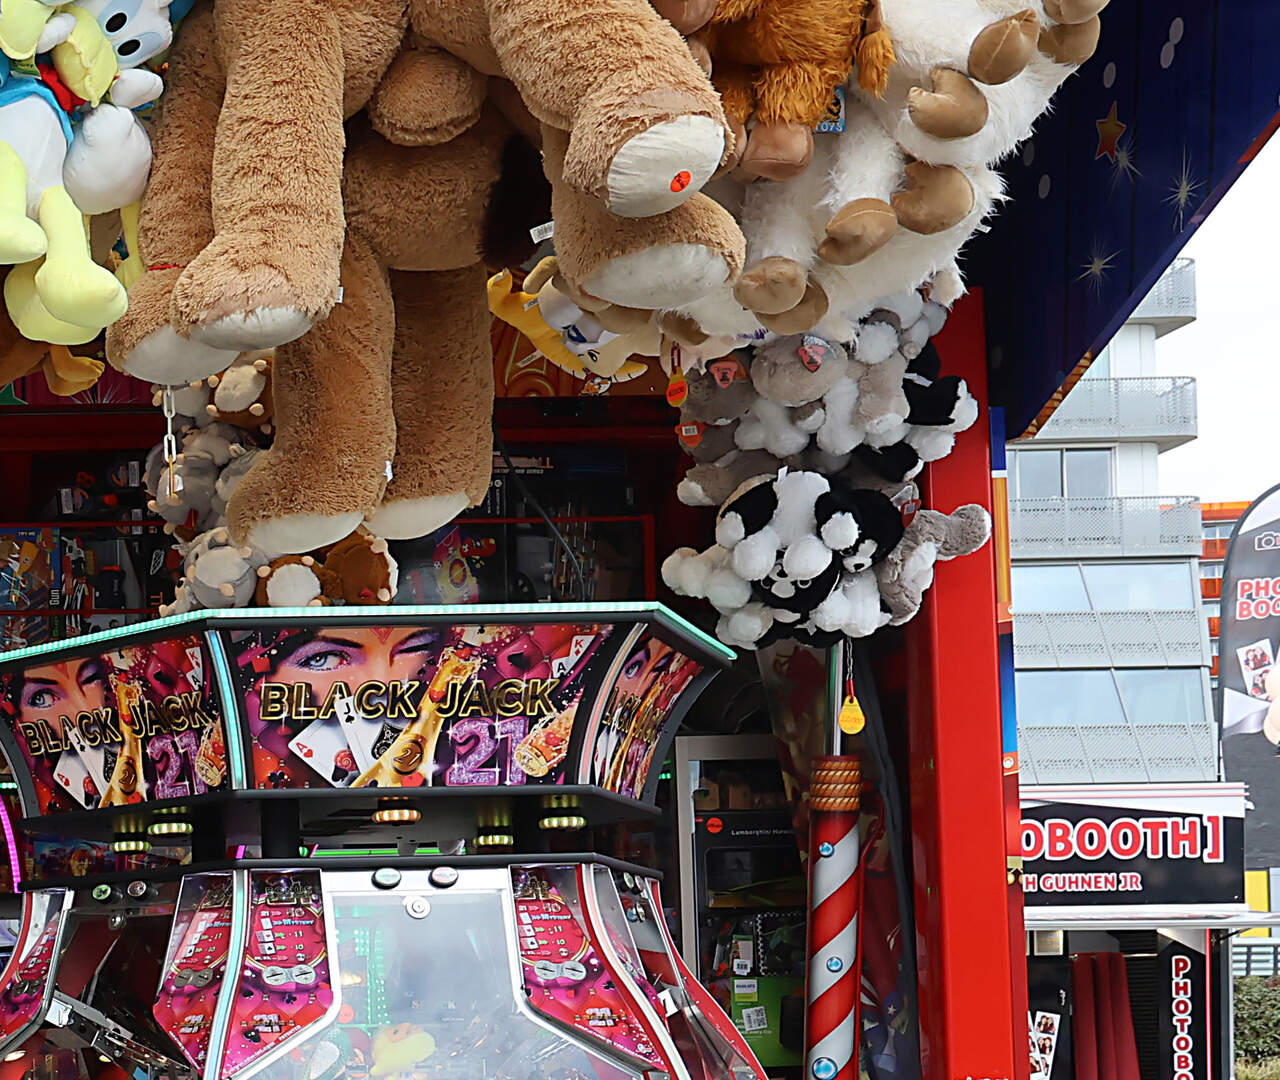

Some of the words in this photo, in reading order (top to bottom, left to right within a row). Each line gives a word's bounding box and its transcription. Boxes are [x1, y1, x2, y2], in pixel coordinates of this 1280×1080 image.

[19, 707, 122, 756] BLACK
[129, 690, 213, 739] JACK
[259, 679, 419, 721] BLACK
[437, 677, 560, 719] JACK
[147, 730, 209, 800] 21
[445, 715, 530, 787] 21
[1039, 872, 1118, 894] GUHNEN
[1117, 872, 1143, 891] JR
